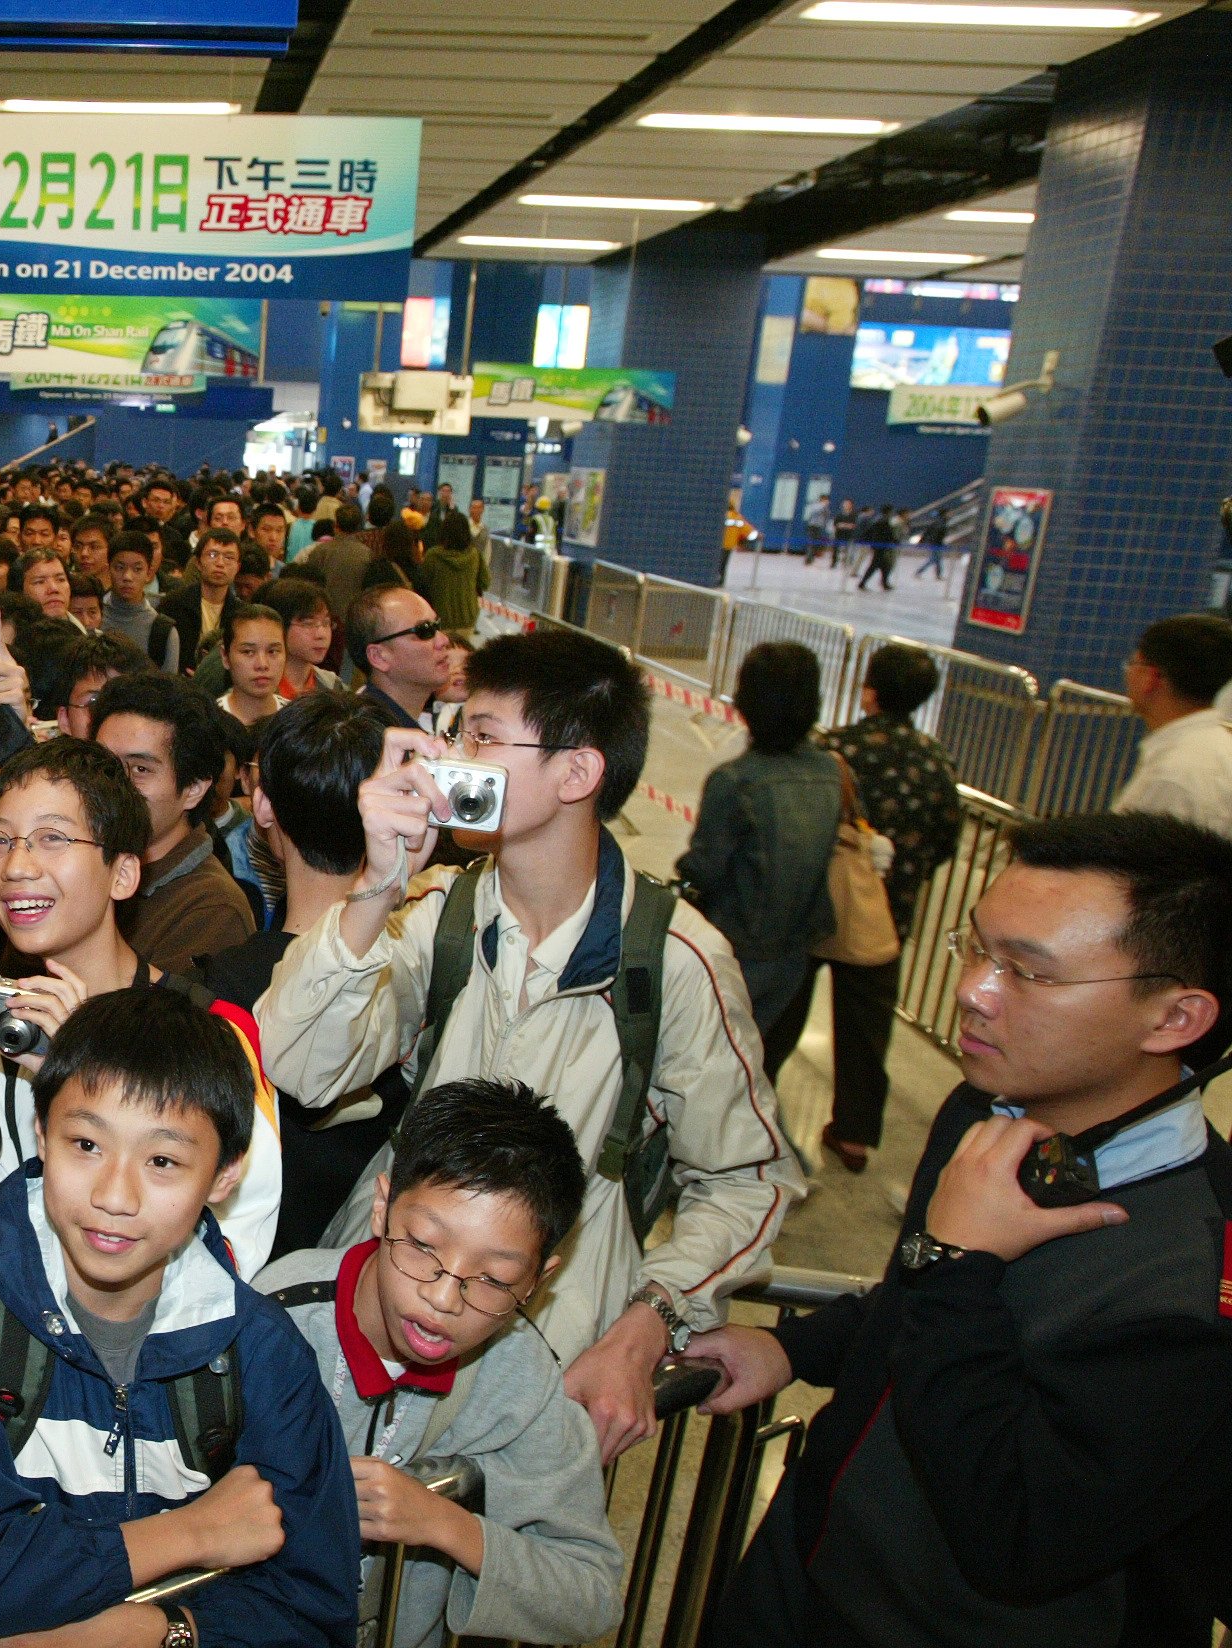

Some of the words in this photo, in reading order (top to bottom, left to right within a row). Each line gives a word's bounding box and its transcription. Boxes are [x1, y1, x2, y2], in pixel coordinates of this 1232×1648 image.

[204, 156, 378, 193] 下午三時
[200, 194, 373, 235] 正式通車
[15, 263, 48, 278] on
[53, 260, 82, 279] 21
[89, 260, 220, 281] December
[224, 262, 294, 284] 2004
[51, 325, 71, 337] Ma
[73, 325, 92, 337] On
[94, 325, 124, 337] Shan
